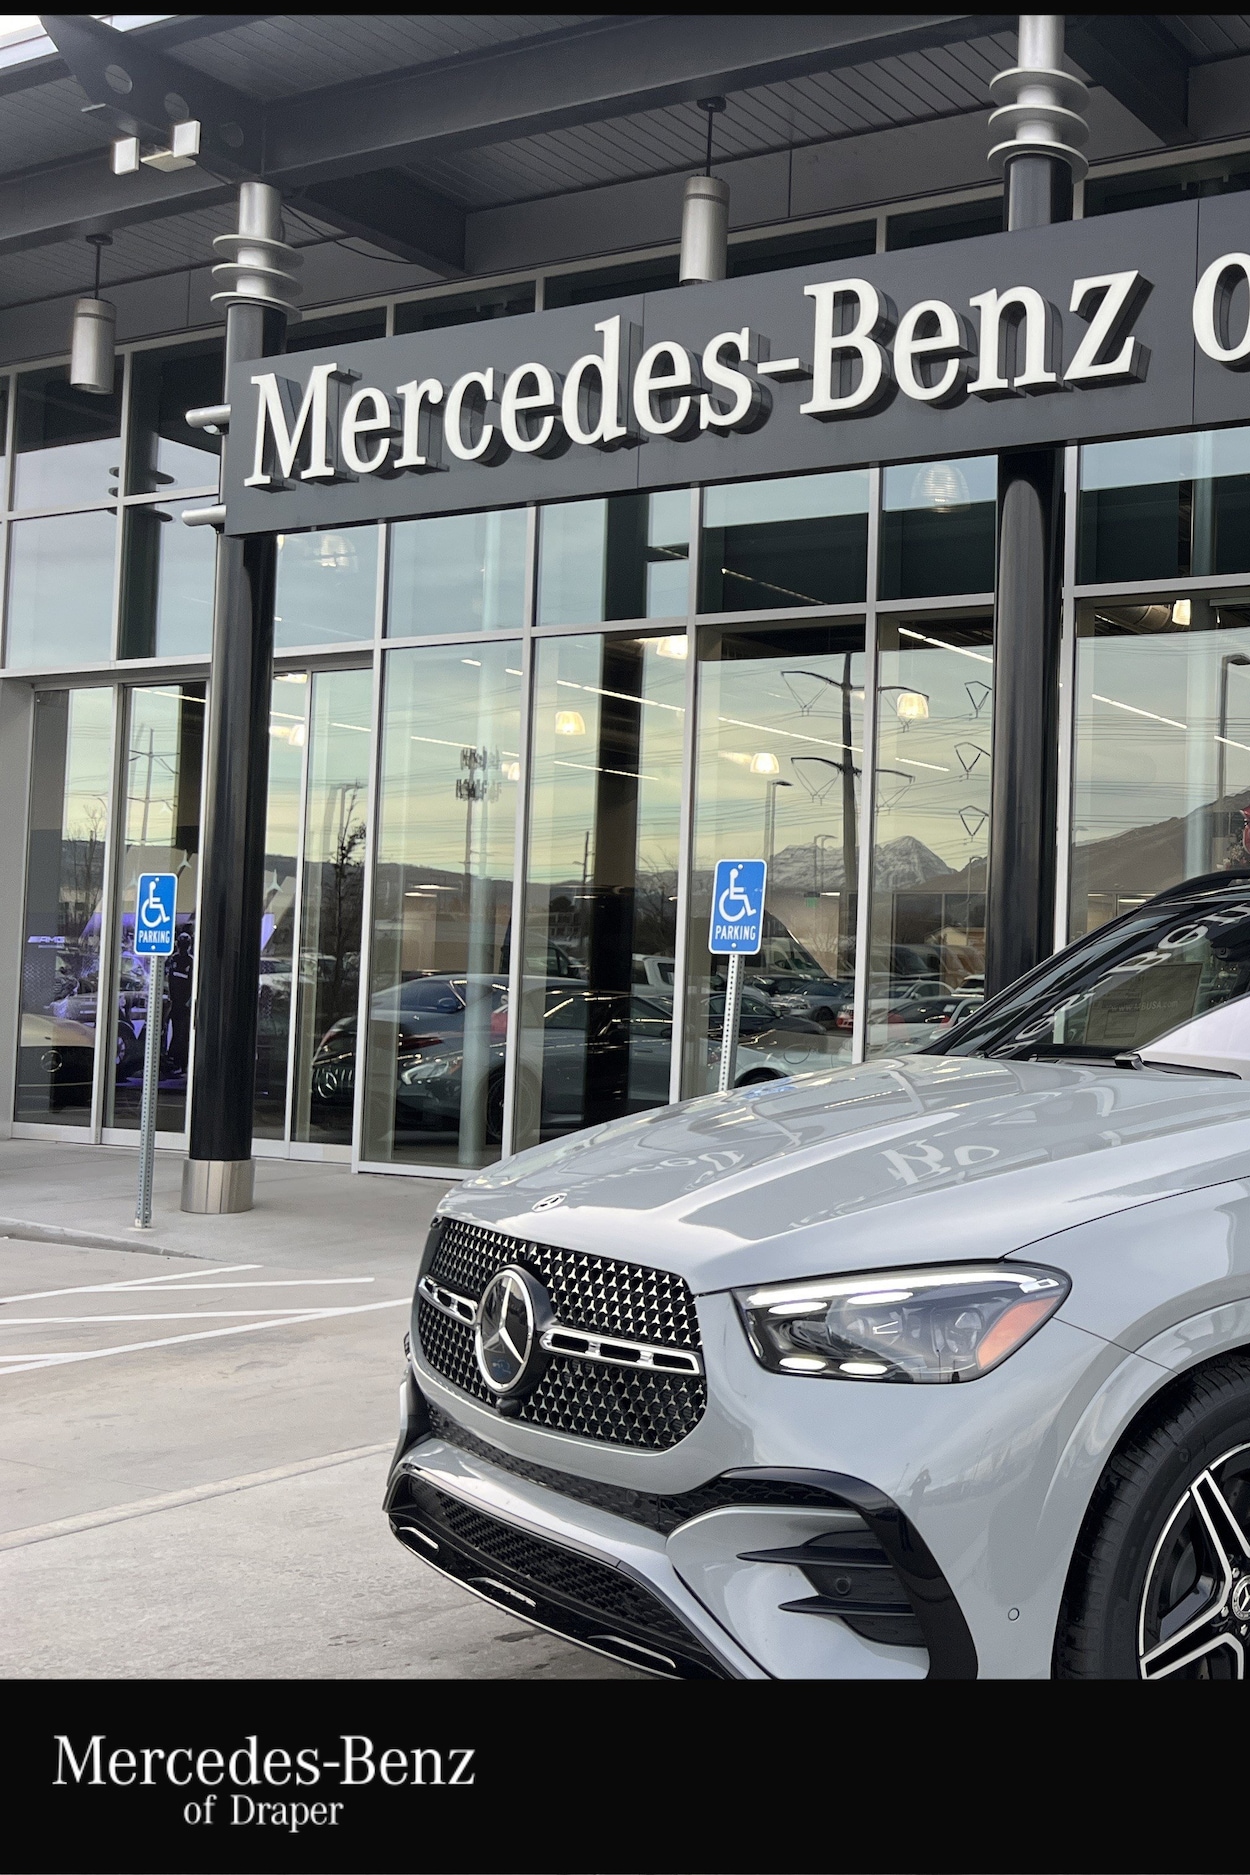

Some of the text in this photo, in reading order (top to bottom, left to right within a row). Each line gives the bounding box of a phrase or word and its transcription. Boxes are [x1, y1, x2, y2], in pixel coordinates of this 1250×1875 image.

[243, 269, 1140, 488] Mercedes-Benz
[138, 929, 170, 944] PARKING
[715, 925, 757, 941] PARKING
